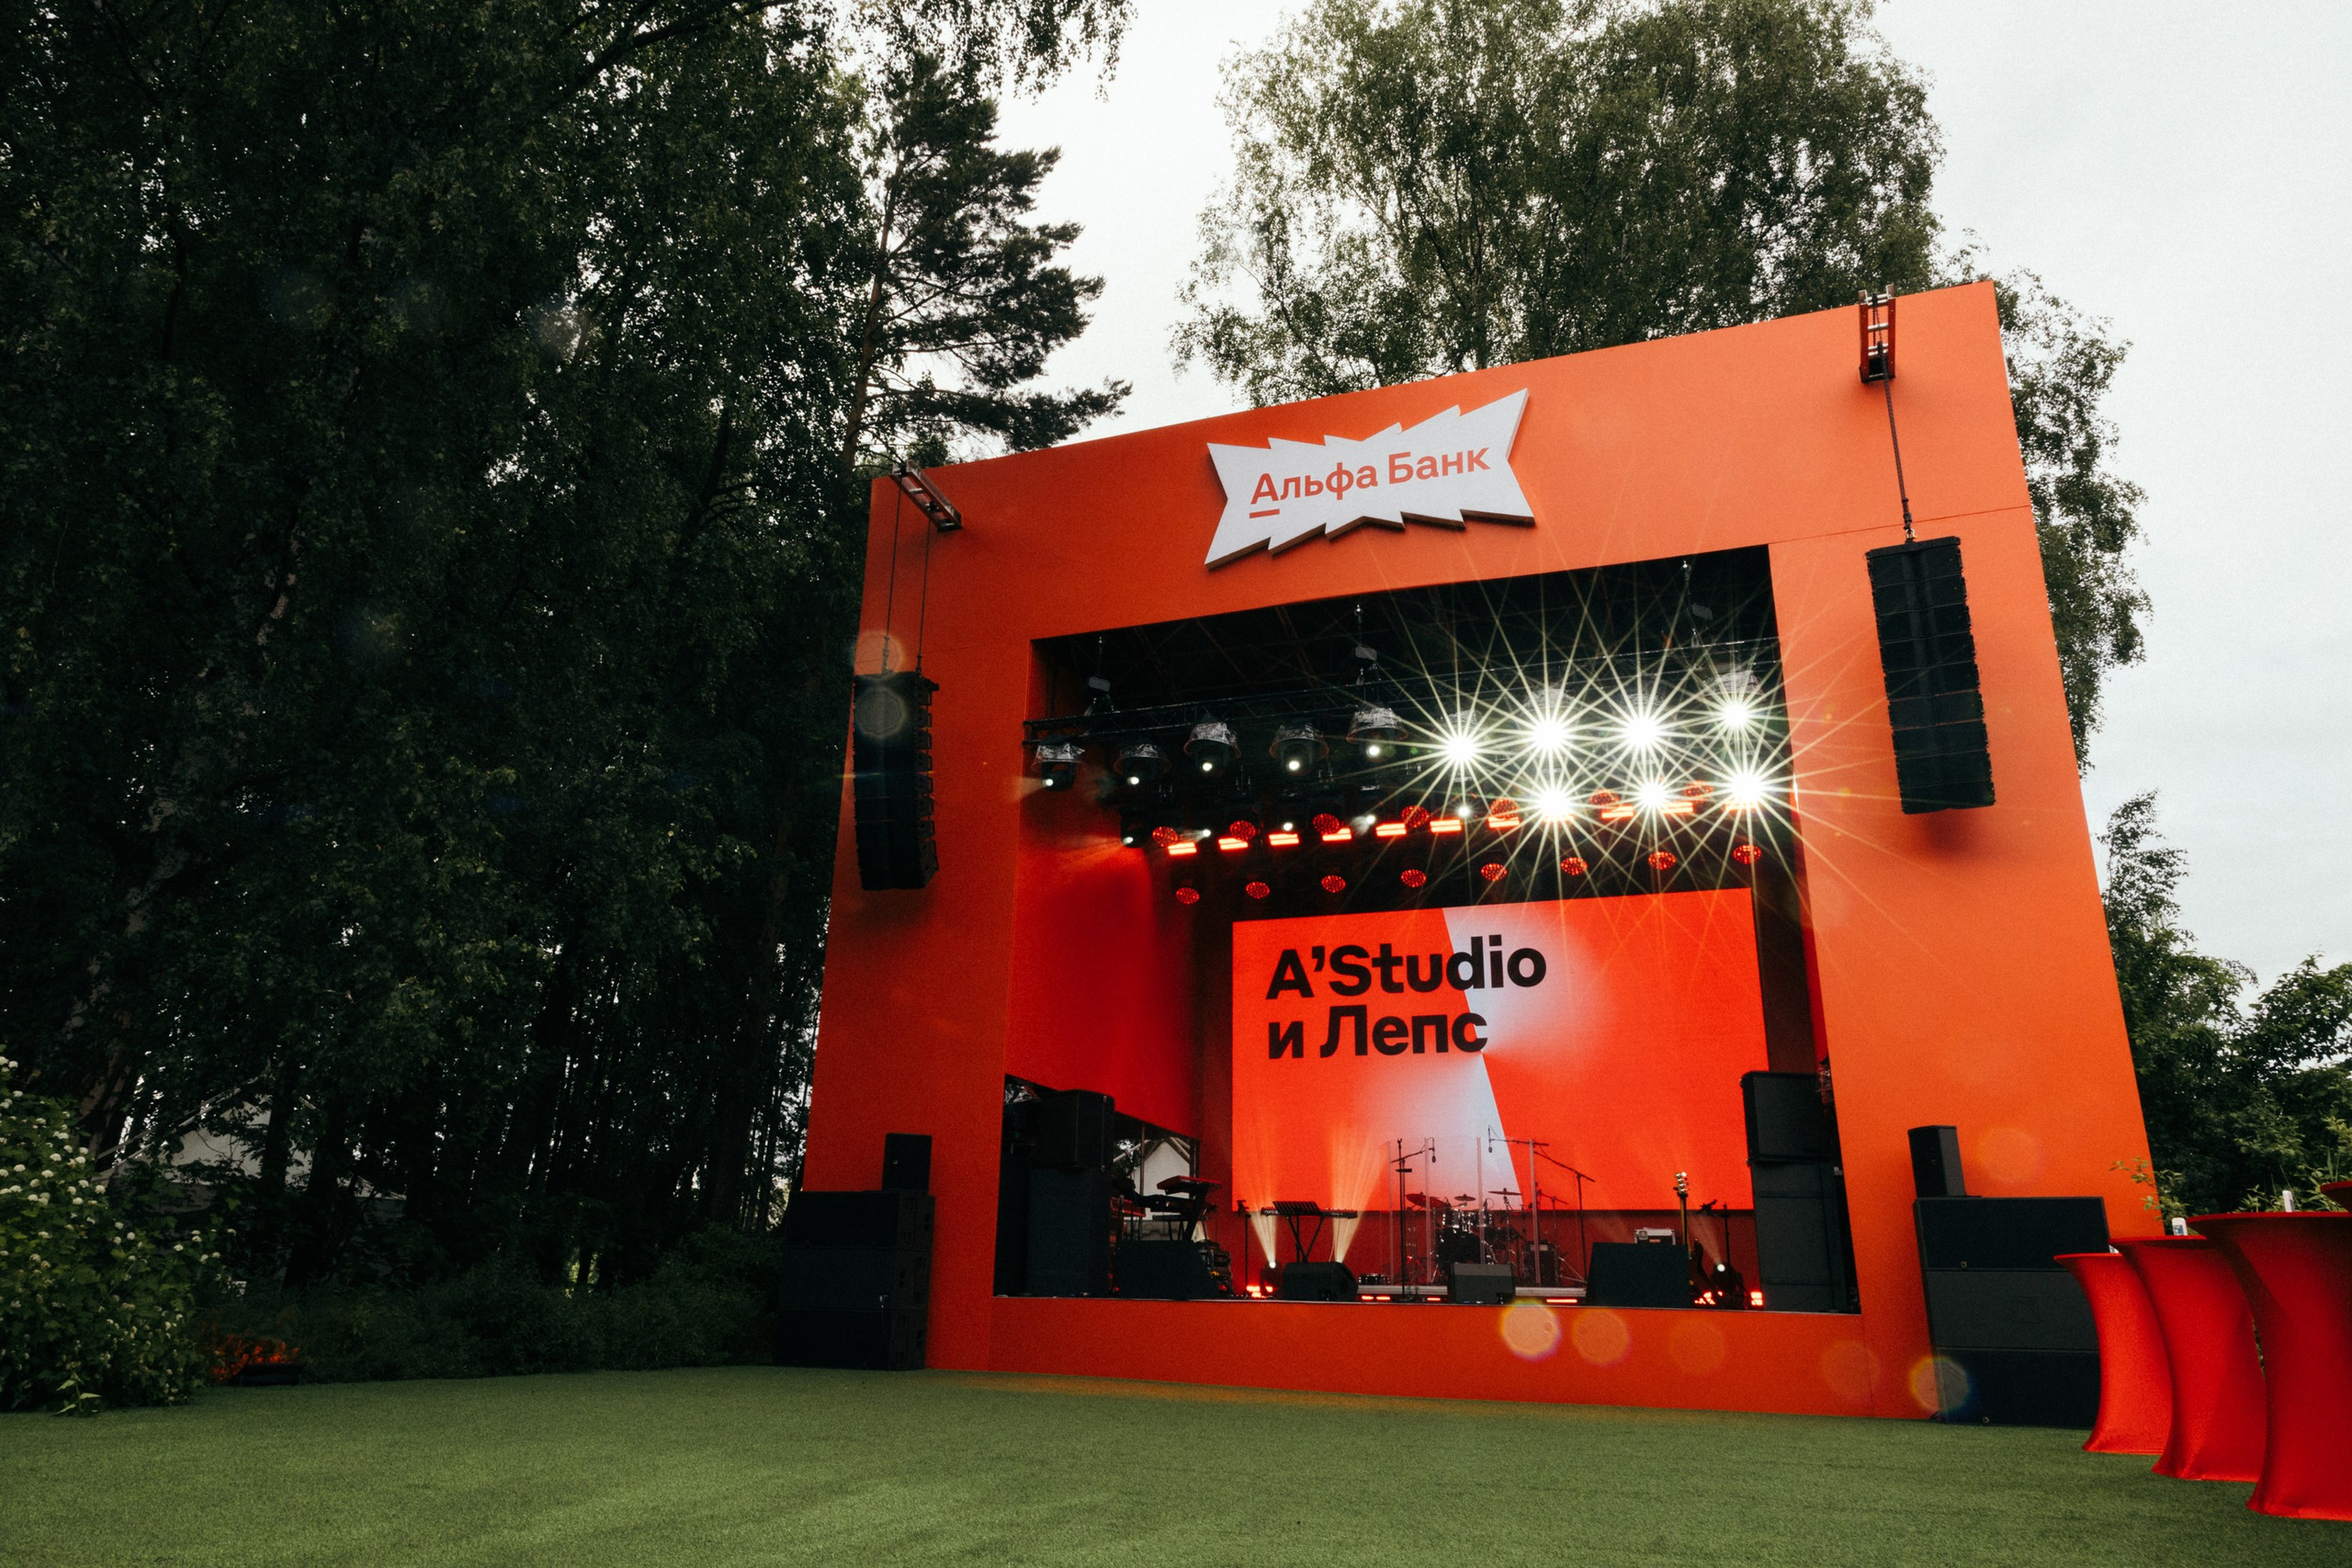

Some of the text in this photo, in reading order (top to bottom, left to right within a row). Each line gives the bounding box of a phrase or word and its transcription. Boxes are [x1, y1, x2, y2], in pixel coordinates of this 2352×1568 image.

[1250, 446, 1491, 505] Альфа Банк
[1265, 934, 1547, 1000] A’Studio
[1268, 1004, 1488, 1060] и Лепс
